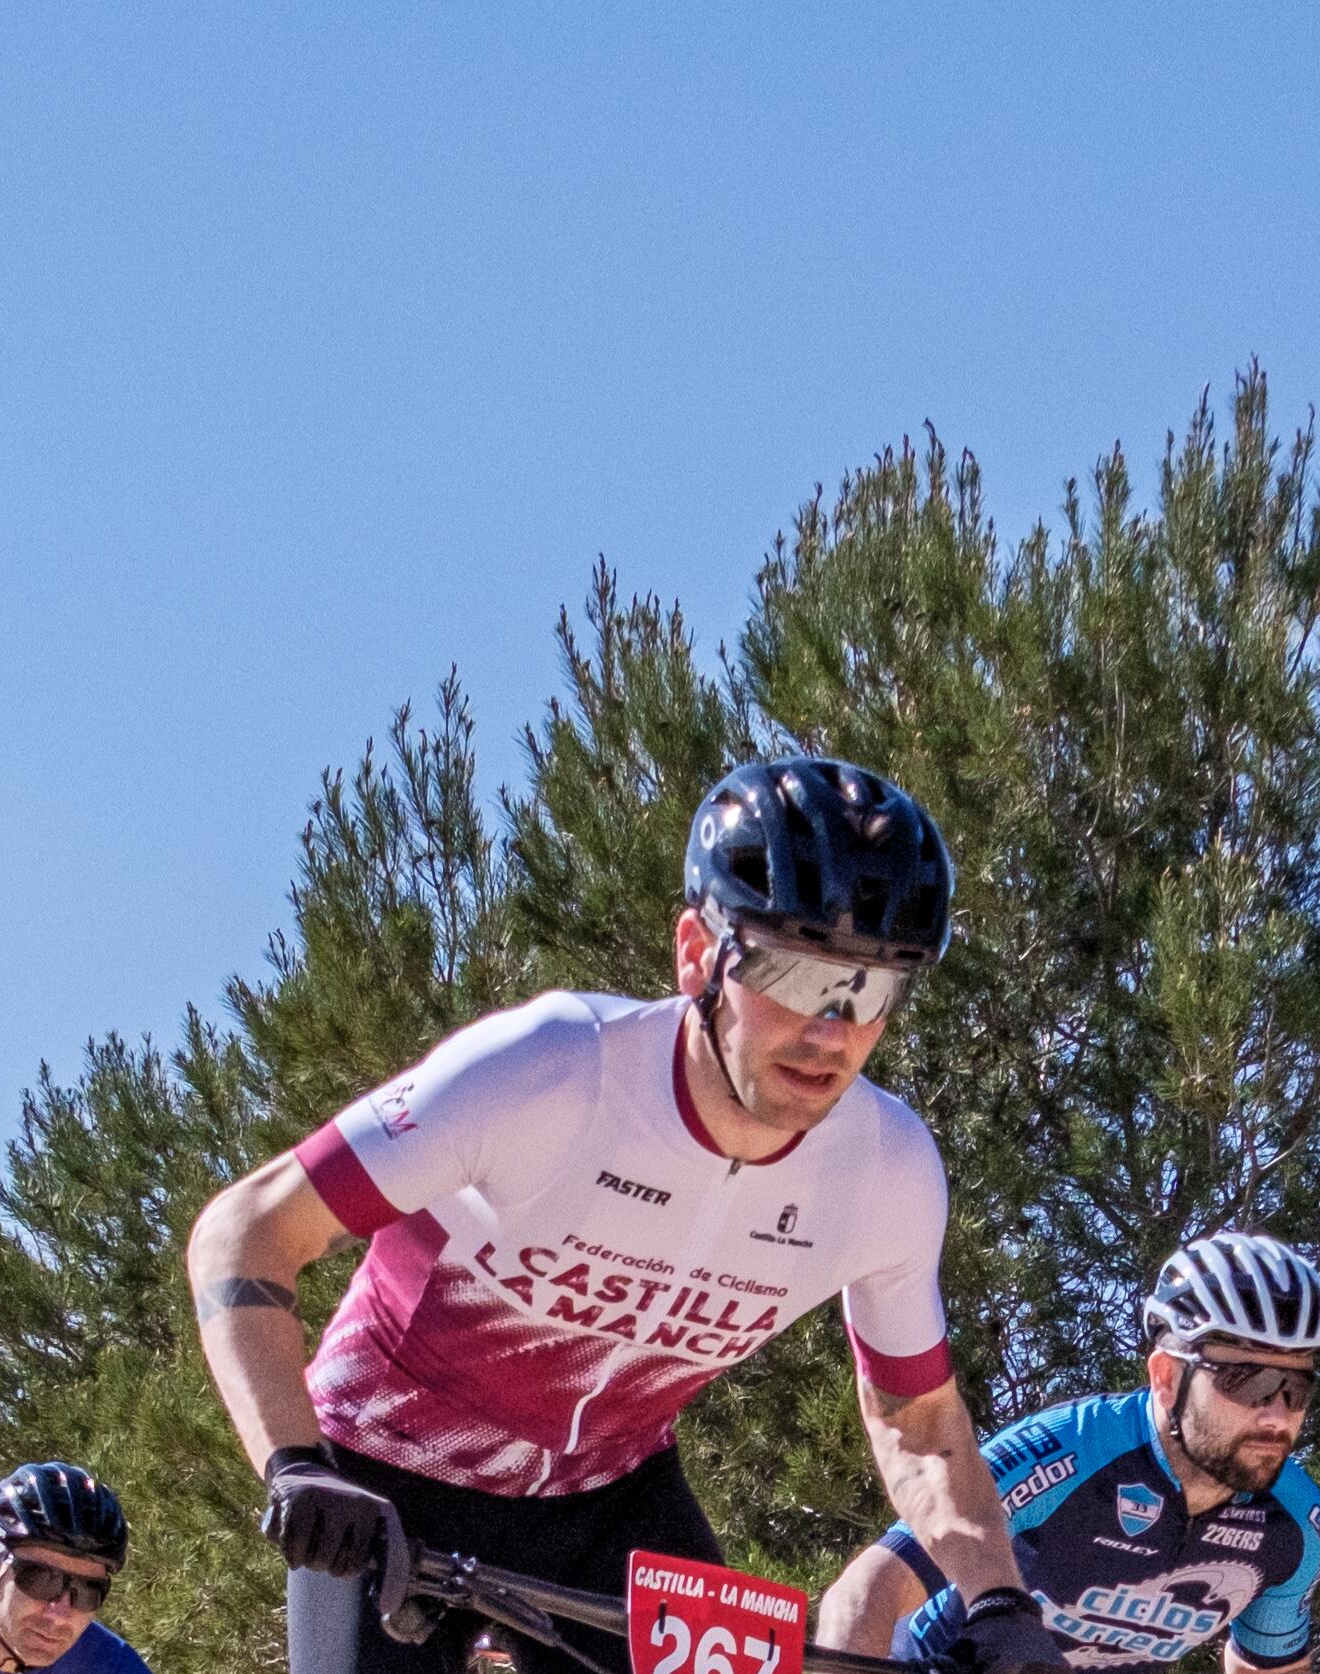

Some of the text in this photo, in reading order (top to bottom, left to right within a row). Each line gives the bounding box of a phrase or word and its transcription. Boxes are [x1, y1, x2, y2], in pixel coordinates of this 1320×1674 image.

[596, 1170, 672, 1207] FASTER
[518, 1245, 780, 1333] CASTILLA
[562, 1234, 789, 1299] Federación de Ciclismo
[547, 1295, 769, 1359] MANCH
[1093, 1536, 1159, 1556] RIDLEY
[1201, 1523, 1265, 1551] 226ERS
[634, 1566, 704, 1599] CASTILLA
[720, 1583, 739, 1606] LA
[741, 1588, 799, 1624] MANCHA
[1081, 1587, 1218, 1633] ciclos
